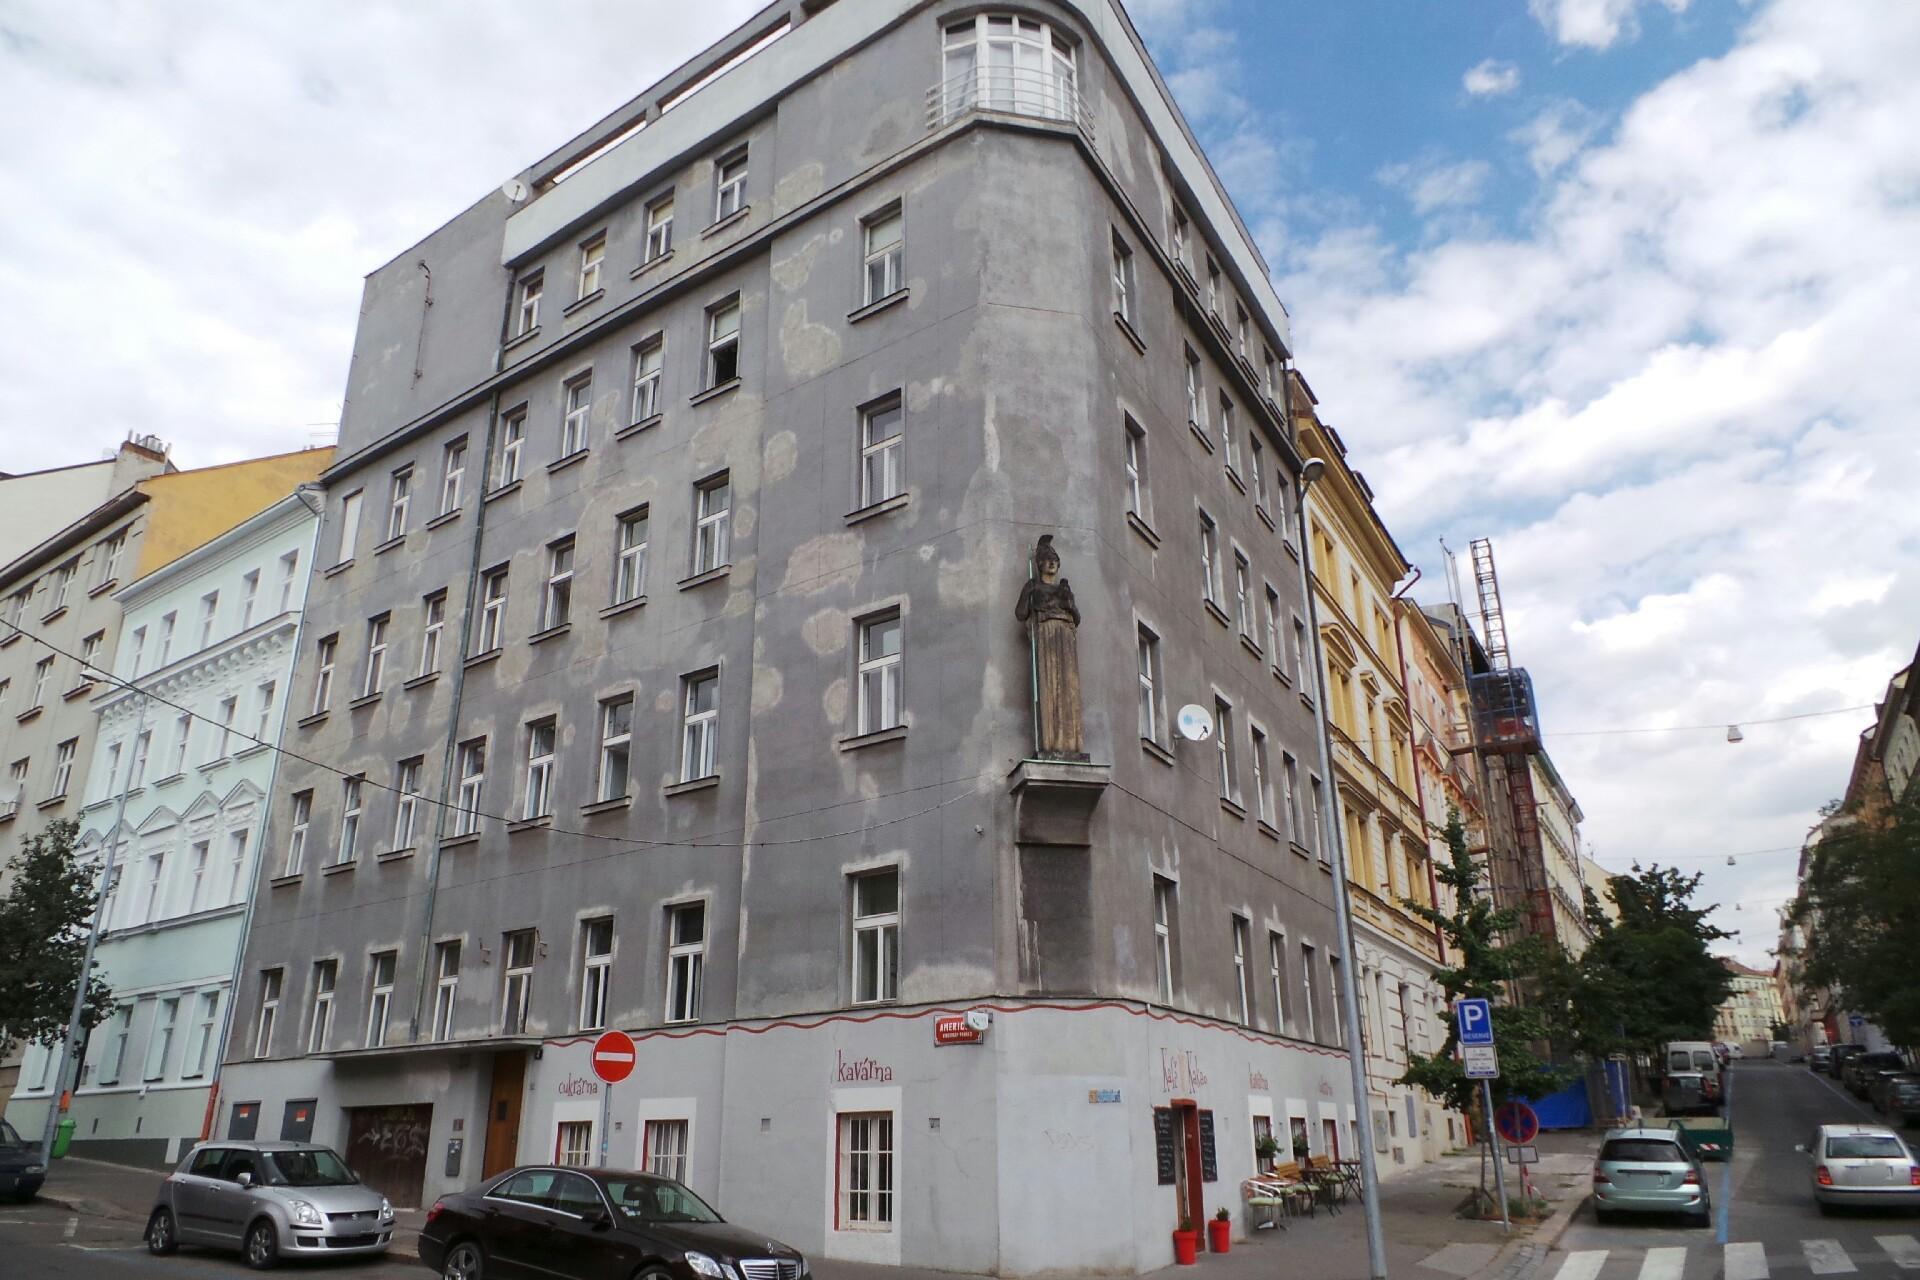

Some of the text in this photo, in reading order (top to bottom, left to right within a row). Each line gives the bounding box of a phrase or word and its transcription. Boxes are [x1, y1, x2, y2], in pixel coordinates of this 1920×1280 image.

[939, 1021, 968, 1032] AMERIC
[1463, 1004, 1483, 1031] P
[838, 1049, 892, 1082] kavárna
[558, 1072, 597, 1096] cukrárna
